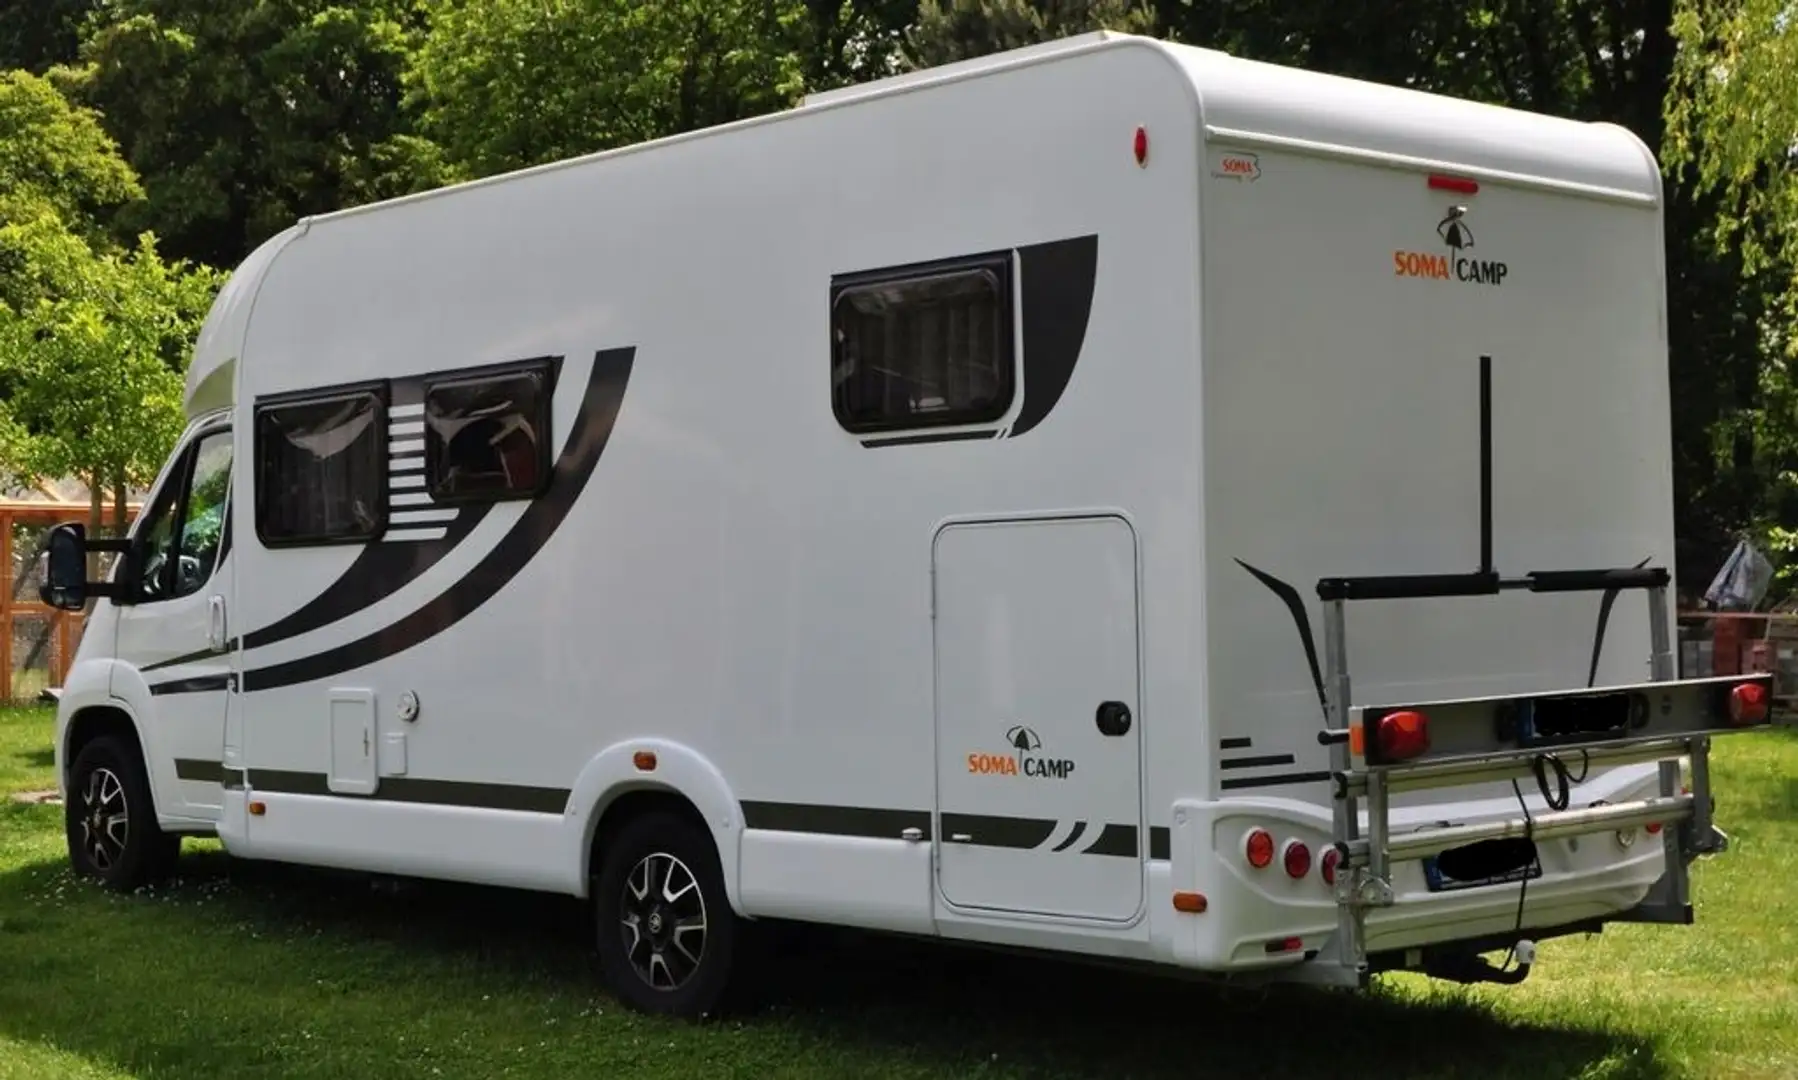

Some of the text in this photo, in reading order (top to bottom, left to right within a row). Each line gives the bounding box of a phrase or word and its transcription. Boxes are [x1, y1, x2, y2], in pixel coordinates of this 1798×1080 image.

[1394, 250, 1508, 286] SOMA CAMP
[967, 753, 1075, 780] SOMA CAMP
